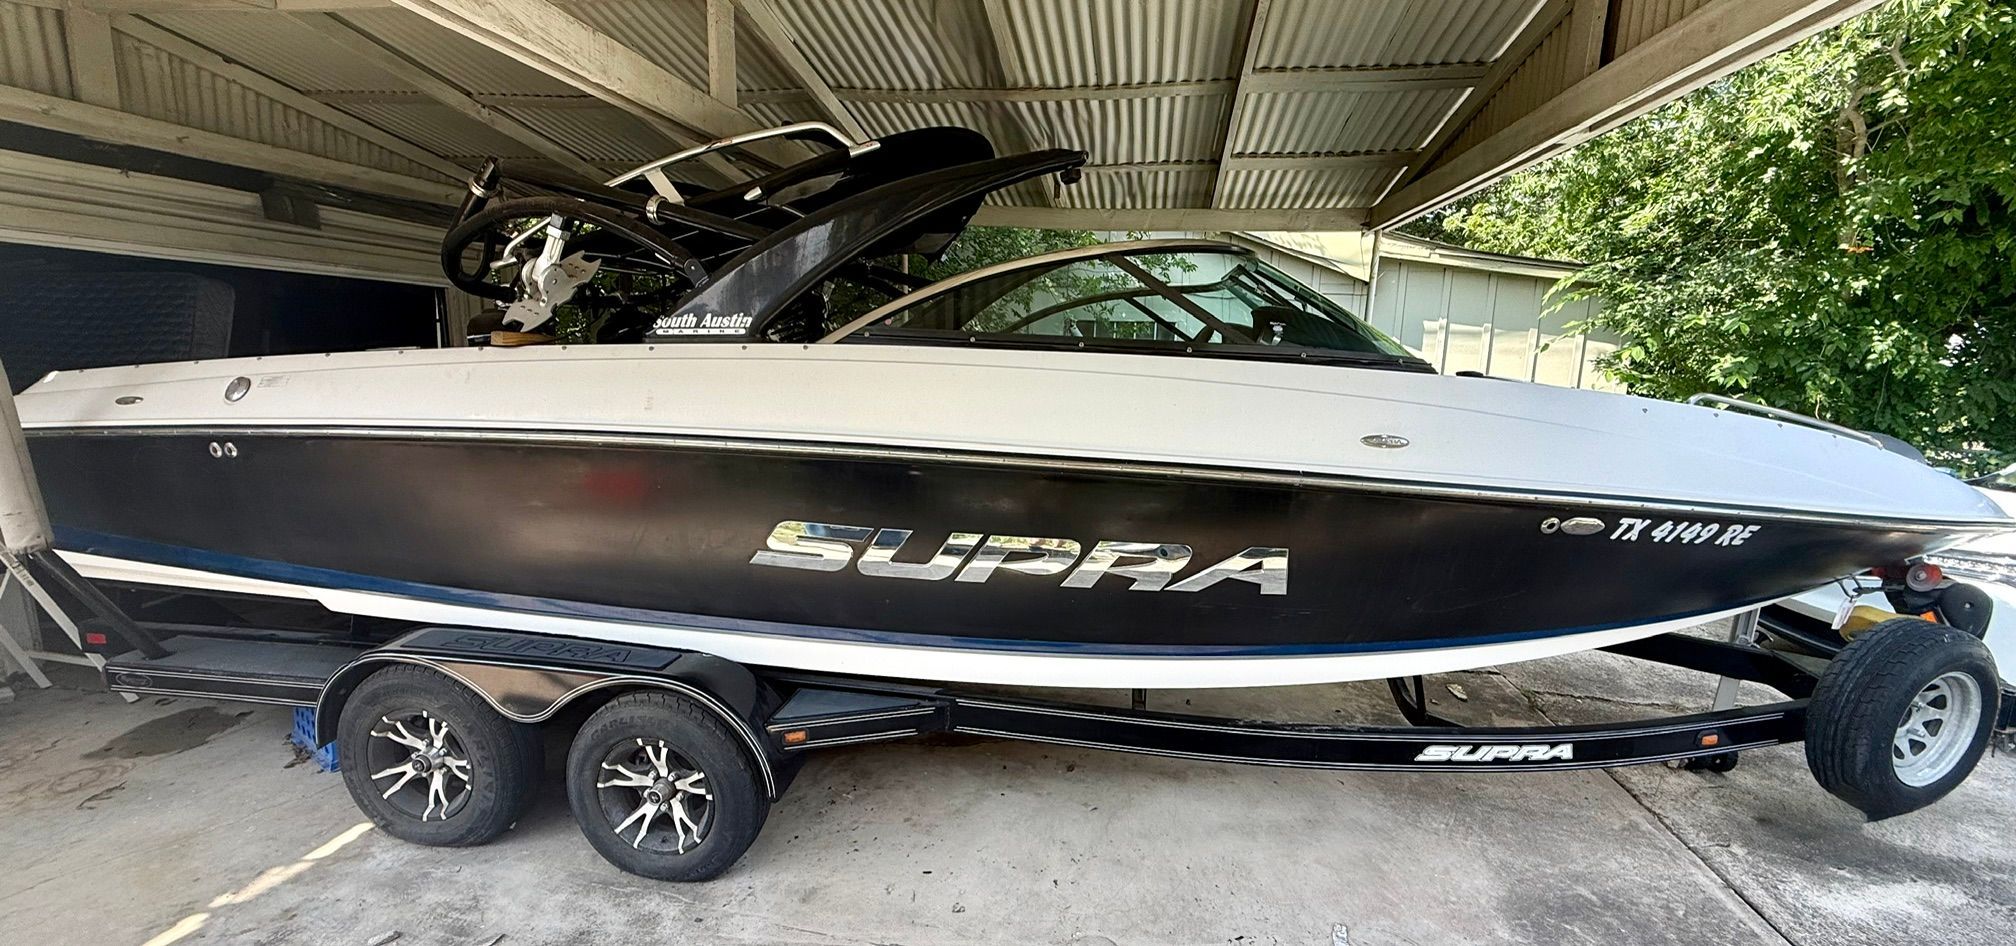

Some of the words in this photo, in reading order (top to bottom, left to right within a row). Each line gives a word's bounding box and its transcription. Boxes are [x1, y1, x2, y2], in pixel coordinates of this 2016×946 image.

[653, 313, 698, 328] South
[700, 313, 753, 328] Austin
[1609, 517, 1652, 541] TX
[1652, 520, 1719, 544] 4149
[1714, 524, 1762, 547] RE
[749, 520, 1289, 595] SUPRA
[441, 634, 632, 662] SUPRA
[1413, 742, 1574, 762] SUPRA
